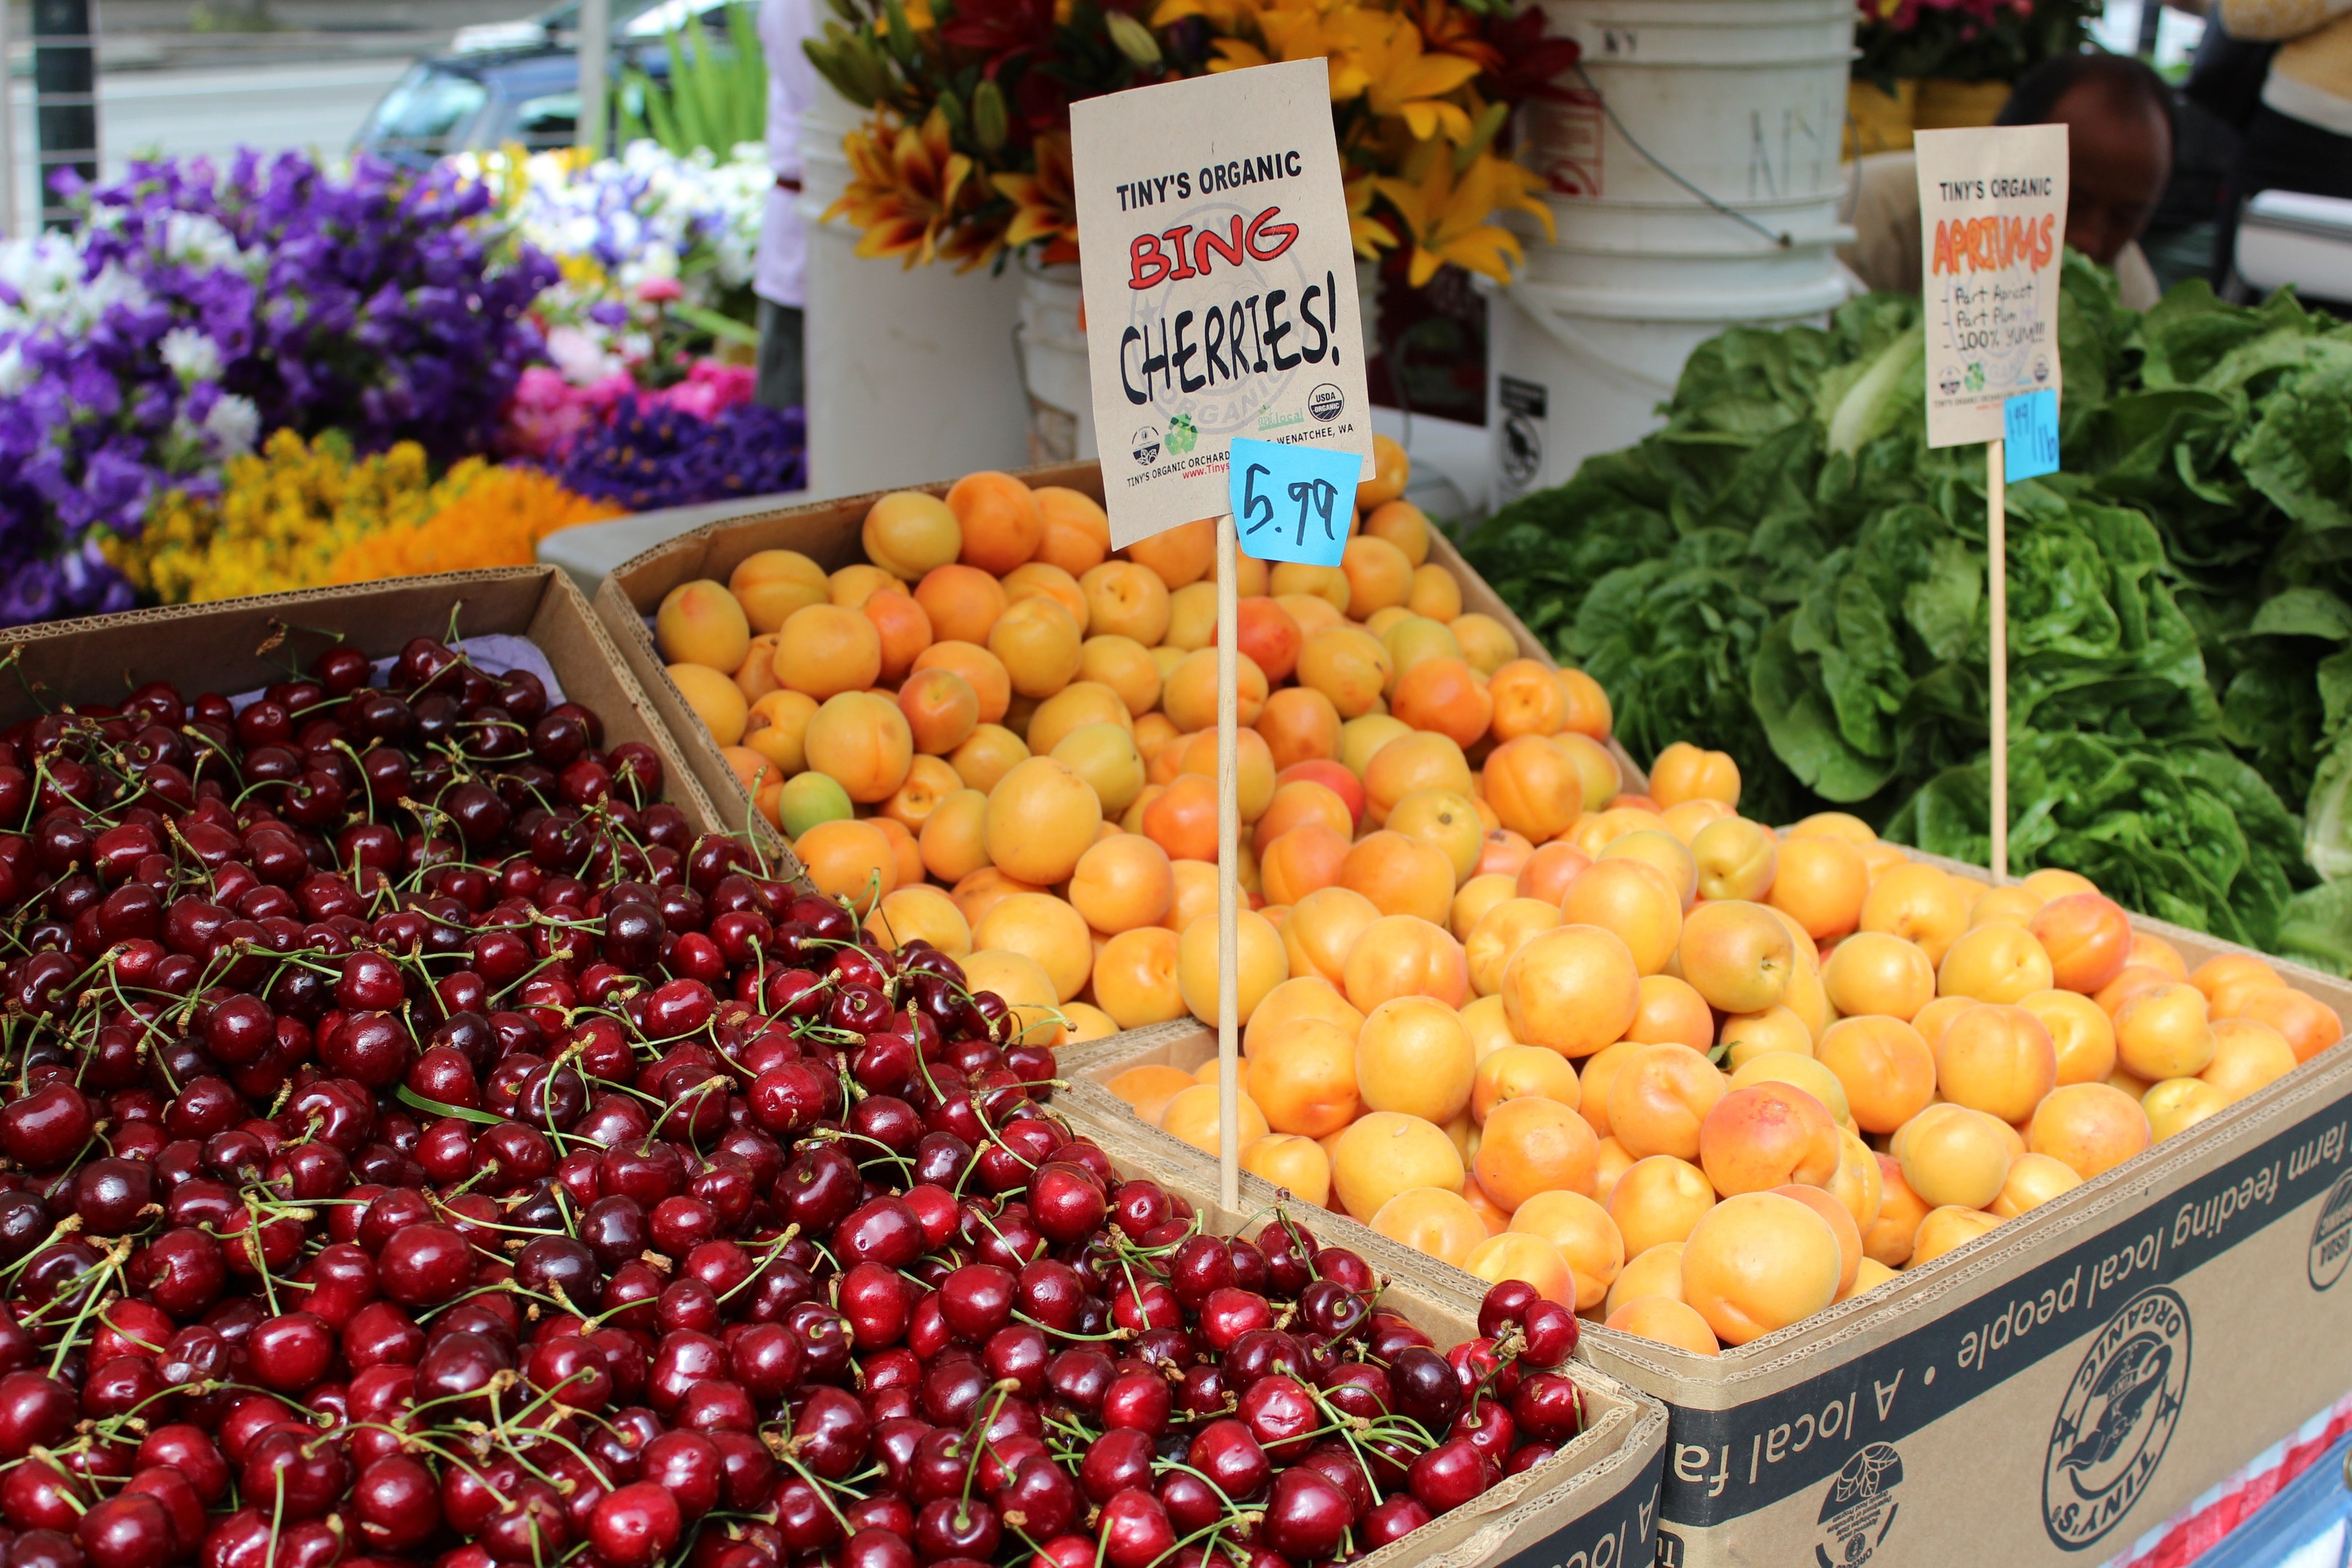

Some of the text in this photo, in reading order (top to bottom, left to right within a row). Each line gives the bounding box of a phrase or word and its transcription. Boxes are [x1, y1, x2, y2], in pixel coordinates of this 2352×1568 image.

[1116, 150, 1302, 211] TINY'S ORGANIC
[1940, 177, 2053, 202] TINY'S ORGANIC
[1128, 206, 1299, 290] BING
[1932, 213, 2056, 276] APRIUMS
[1956, 283, 2034, 305] Part Apricot
[1957, 307, 2018, 327] Part Plum
[1120, 270, 1340, 405] CHERRIES!
[1959, 330, 2000, 351] 100%
[1158, 369, 1285, 425] ORGANIC
[1314, 402, 1340, 414] ORGANIC
[1316, 392, 1336, 403] USDA
[1127, 473, 1150, 488] TINY'S
[1152, 460, 1186, 478] ORGANIC
[1276, 426, 1335, 444] WENATCHEE,
[1338, 423, 1354, 434] WA
[1244, 462, 1339, 547] 5.99
[1958, 1120, 2347, 1371] farm feeding local people
[2079, 1298, 2181, 1392] ORGANIC
[1873, 1368, 1905, 1421] A
[1748, 1392, 1857, 1485] local
[1638, 1482, 1659, 1544] A
[2058, 1451, 2156, 1537] TINY'S
